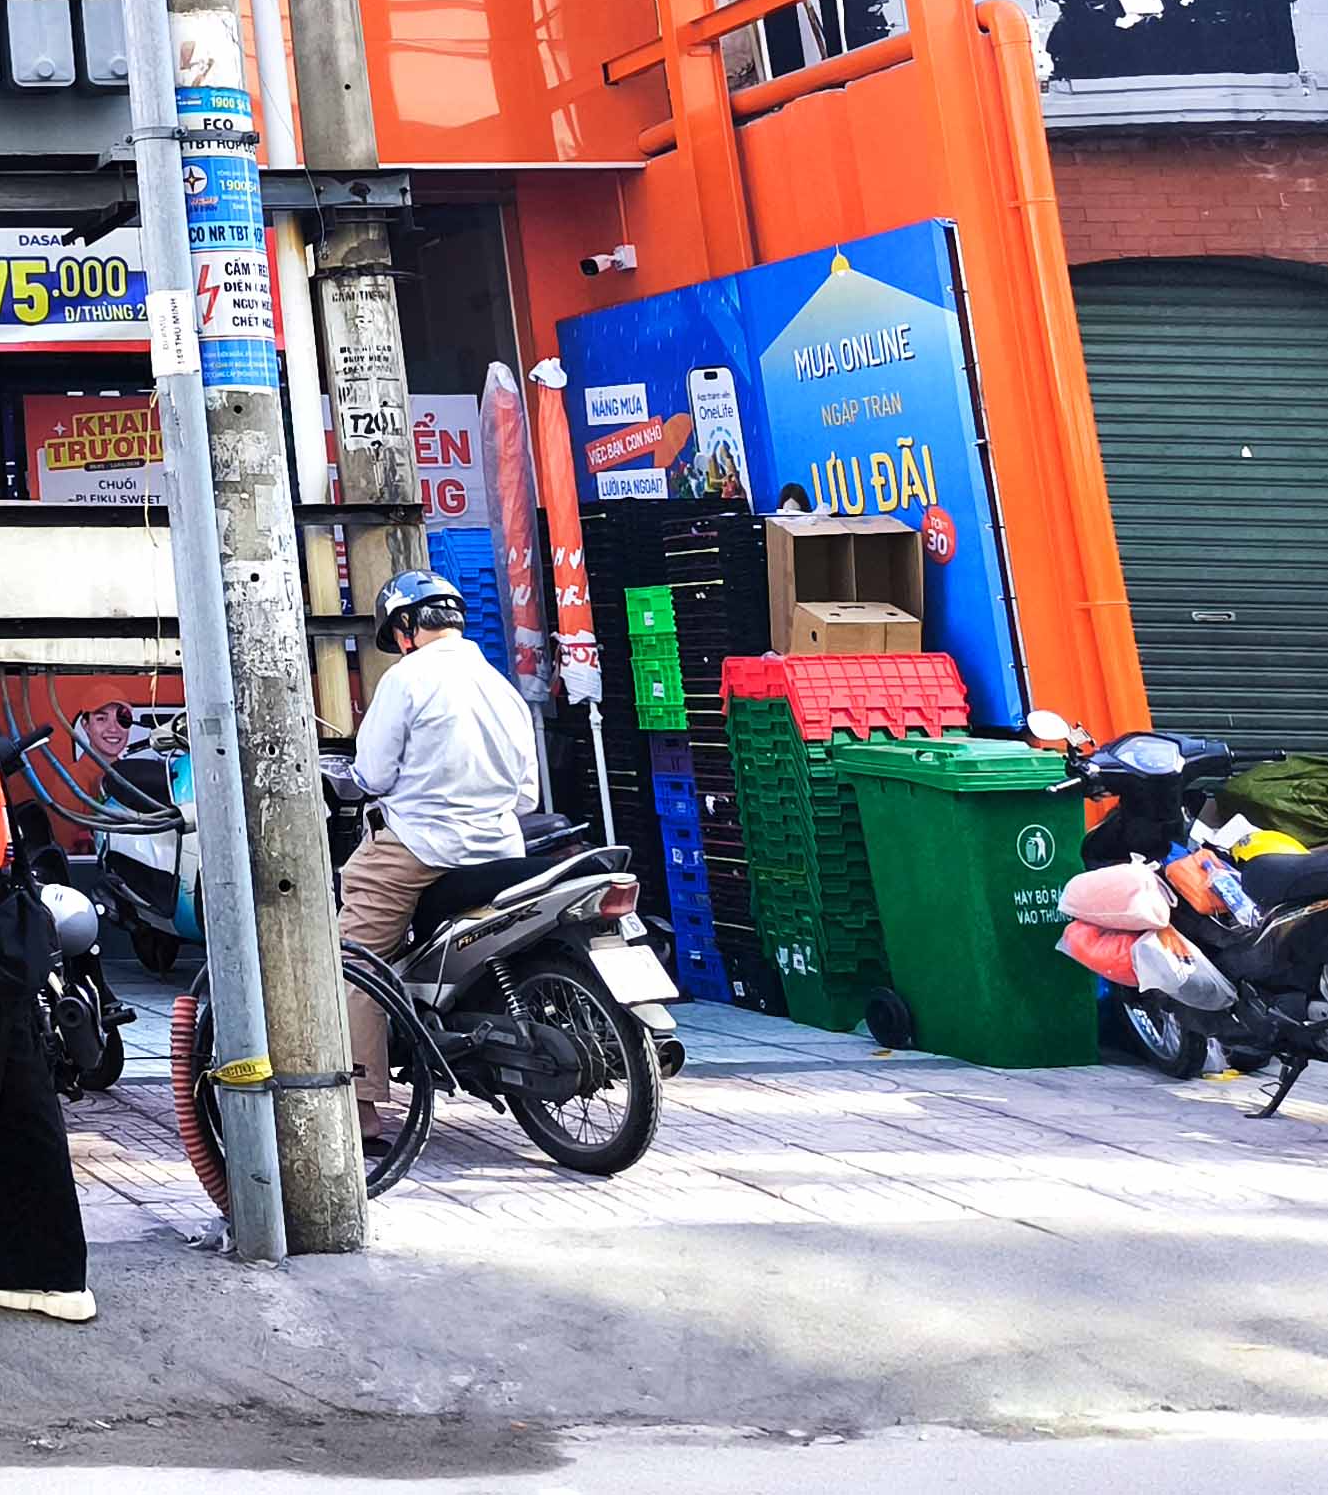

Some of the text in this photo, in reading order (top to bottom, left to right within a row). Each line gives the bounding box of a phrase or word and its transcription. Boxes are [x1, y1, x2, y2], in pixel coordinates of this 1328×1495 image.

[18, 234, 75, 247] DASA
[64, 300, 148, 323] Đ/THÙNG 2
[794, 323, 916, 382] MUA ONLINE
[621, 396, 643, 416] MƯA
[699, 404, 734, 420] OneLife
[821, 387, 903, 426] NGẬP TRÀN
[47, 434, 163, 463] TRƯƠN
[626, 432, 644, 453] CON
[98, 477, 136, 490] CHUỐI
[810, 436, 939, 515] ƯU ĐÃI
[621, 479, 633, 495] RA
[927, 529, 948, 555] 30
[1016, 906, 1038, 925] VÀO
